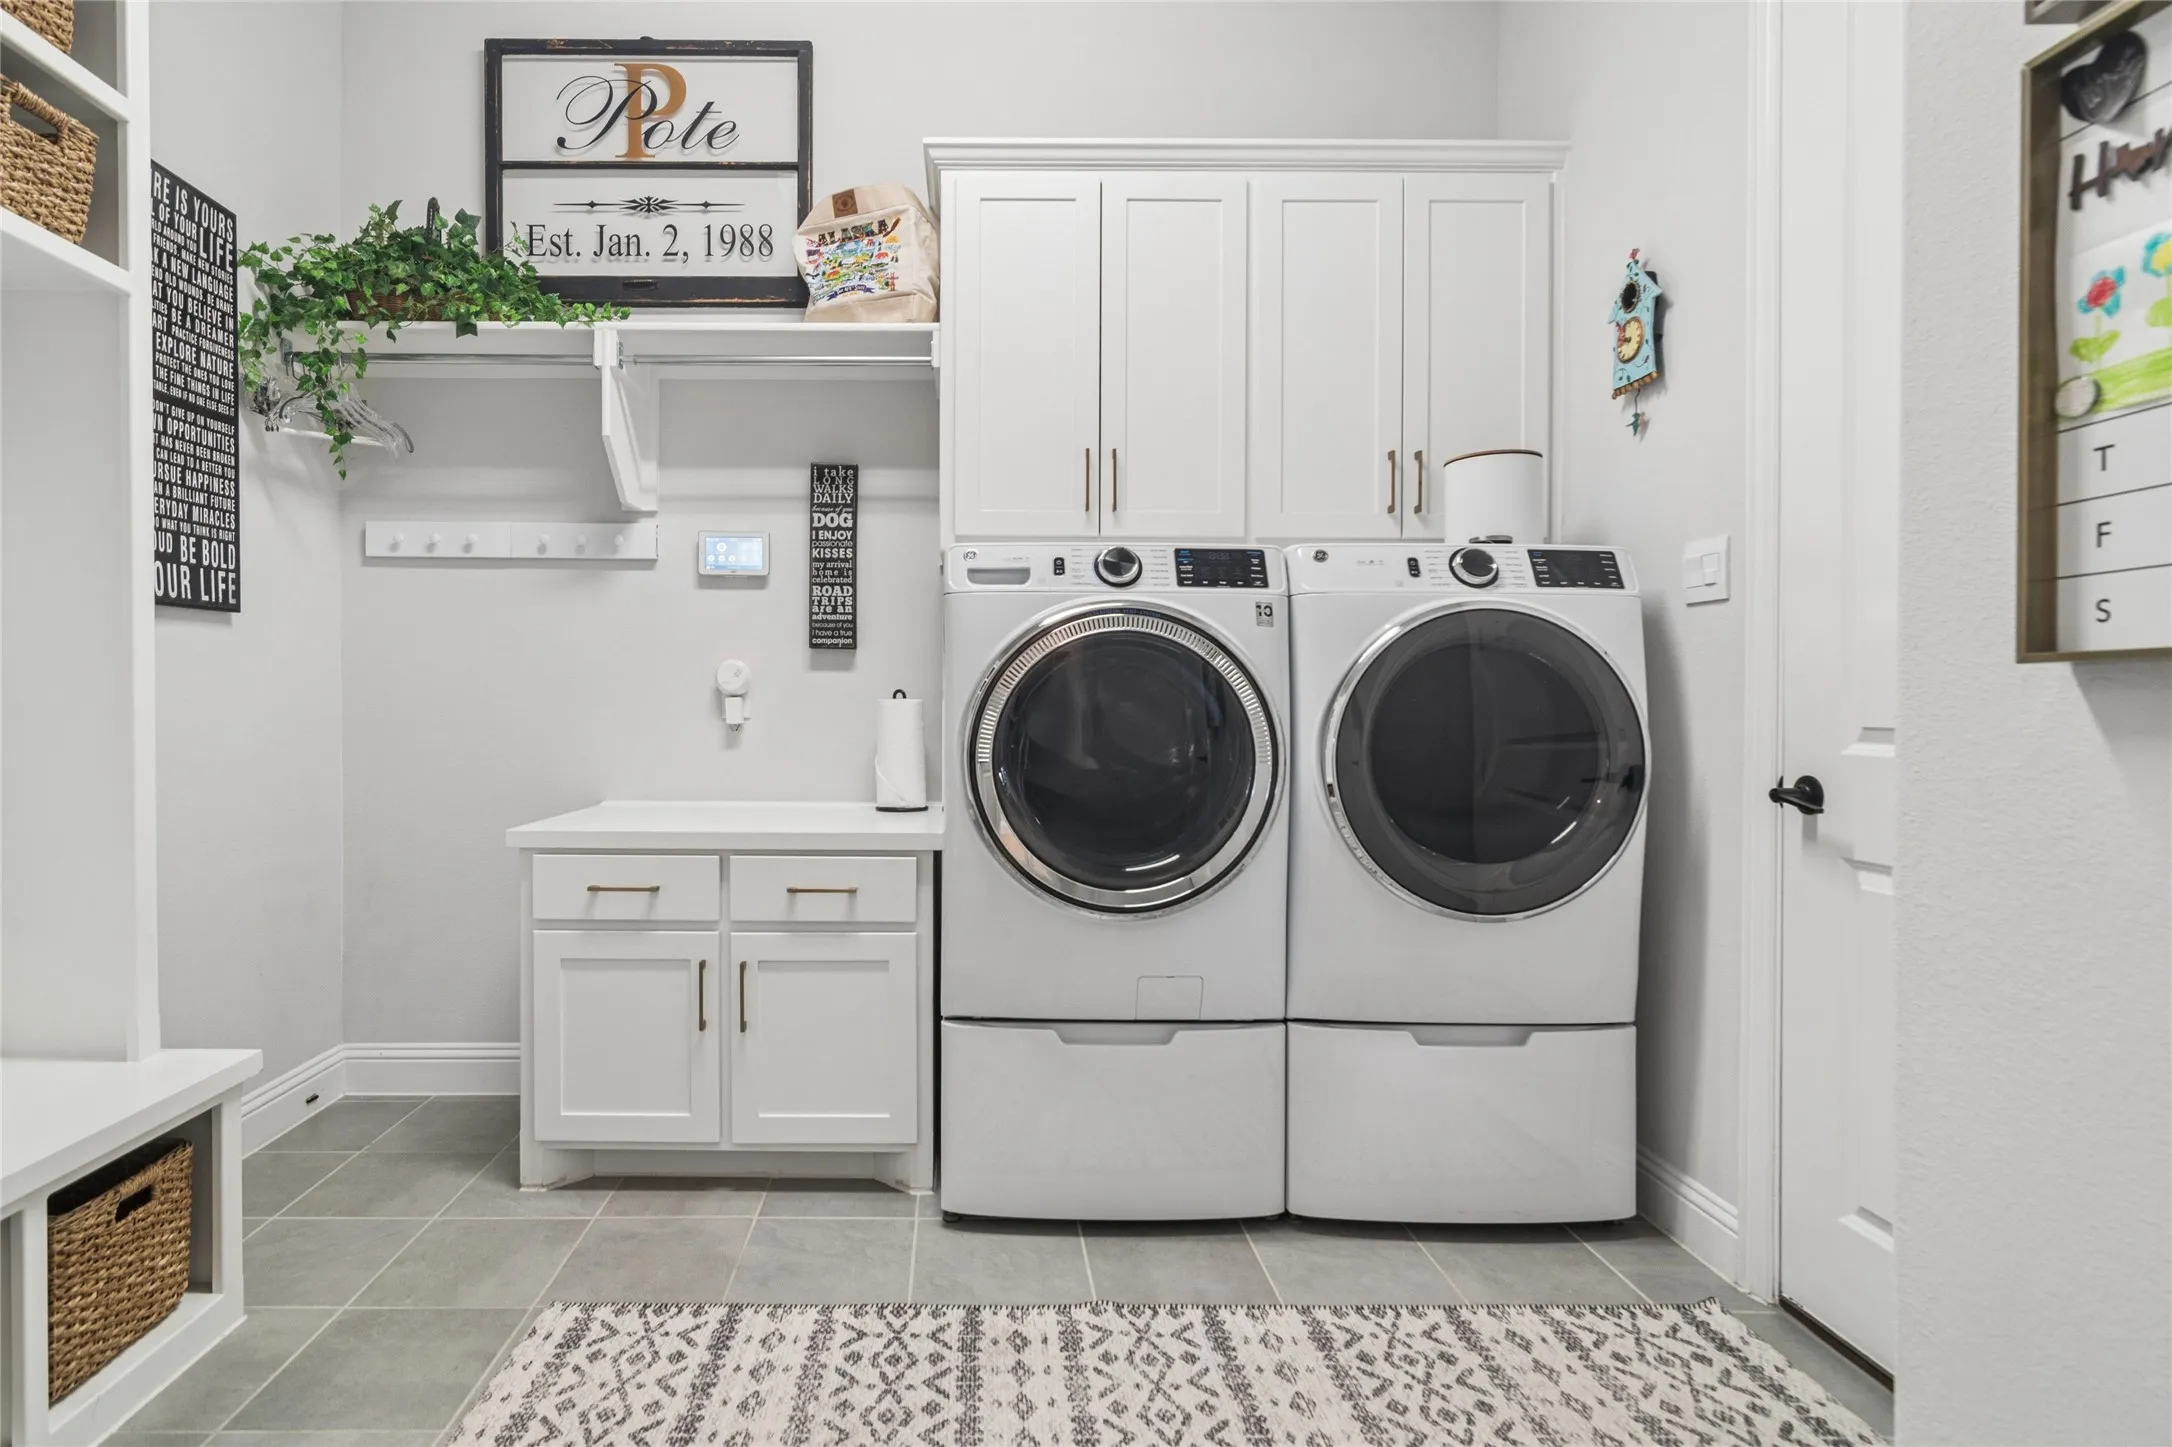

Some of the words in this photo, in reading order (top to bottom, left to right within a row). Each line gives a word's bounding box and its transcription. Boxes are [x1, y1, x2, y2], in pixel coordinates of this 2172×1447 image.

[556, 75, 740, 151] Pote
[175, 186, 188, 215] IS
[193, 196, 233, 242] YOURS
[159, 203, 170, 223] OF
[174, 212, 197, 240] YOUR
[200, 227, 233, 273] LIFE
[163, 225, 185, 246] AROUND
[186, 238, 197, 252] YOU
[528, 224, 580, 257] Est.
[592, 224, 650, 258] Jan.
[663, 224, 689, 264] 2,
[704, 224, 774, 257] 1988
[162, 252, 168, 269] A
[171, 256, 189, 279] NEW
[192, 267, 233, 302] LANGUAGE
[181, 249, 196, 266] MAKE
[198, 258, 210, 272] NEW
[211, 265, 233, 285] STORIES
[164, 272, 177, 287] OLD
[207, 293, 215, 306] BE
[216, 298, 233, 315] BRAVE
[166, 286, 184, 309] YOU
[188, 297, 222, 327] BELIEVE
[225, 315, 234, 332] IN
[171, 308, 182, 325] BE
[185, 315, 191, 330] A
[195, 319, 234, 348] DREAMER
[171, 325, 197, 345] PRACTICE
[199, 337, 234, 360] FORGIVENESS
[156, 332, 196, 364] EXPLORE
[200, 350, 234, 379] NATURE
[155, 352, 180, 371] PROTECT
[181, 362, 192, 375] THE
[193, 367, 208, 381] ONES
[209, 373, 220, 386] YOU
[221, 378, 234, 391] LOVE
[155, 365, 168, 380] THE
[170, 370, 185, 388] FINE
[186, 376, 211, 397] THINGS
[212, 387, 220, 400] IN
[221, 390, 234, 406] LIFE
[171, 405, 185, 420] GIVE
[187, 411, 195, 422] UP
[196, 414, 205, 426] ON
[206, 418, 234, 436] YOURSELF
[167, 417, 235, 454] OPPORTUNITIES
[156, 447, 168, 461] CAN
[170, 451, 184, 466] LEAD
[186, 456, 194, 469] TO
[196, 459, 200, 470] A
[202, 460, 222, 476] BETTER
[224, 466, 235, 479] YOU
[161, 435, 173, 449] HAS
[175, 439, 194, 455] NEVER
[196, 445, 210, 459] BEEN
[213, 450, 235, 467] BROKEN
[2093, 444, 2115, 471] T
[186, 469, 235, 498] HAPPINESS
[813, 476, 854, 485] LONG
[824, 465, 854, 476] take
[165, 483, 171, 497] A
[172, 485, 208, 506] BRILLIANT
[210, 494, 235, 512] FUTURE
[813, 484, 854, 494] WALKS
[813, 493, 853, 503] DAILY
[161, 518, 178, 531] WHAT
[179, 521, 190, 534] YOU
[192, 524, 210, 538] THINK
[211, 528, 217, 539] IS
[219, 530, 235, 542] RIGHT
[192, 505, 235, 530] MIRACLES
[812, 512, 853, 528] DOG
[812, 540, 853, 548] passionate
[818, 531, 853, 540] ENJOY
[2096, 521, 2112, 548] F
[180, 535, 197, 564] BE
[202, 539, 236, 570] BOLD
[812, 548, 853, 558] KISSES
[812, 561, 825, 569] my
[826, 560, 852, 568] arrival
[200, 567, 236, 604] LIFE
[812, 568, 839, 576] home
[843, 568, 853, 576] is
[812, 575, 853, 583] celebrated
[812, 586, 853, 596] ROAD
[812, 596, 853, 605] TRIPS
[2095, 598, 2112, 622] S
[812, 637, 853, 647] companion
